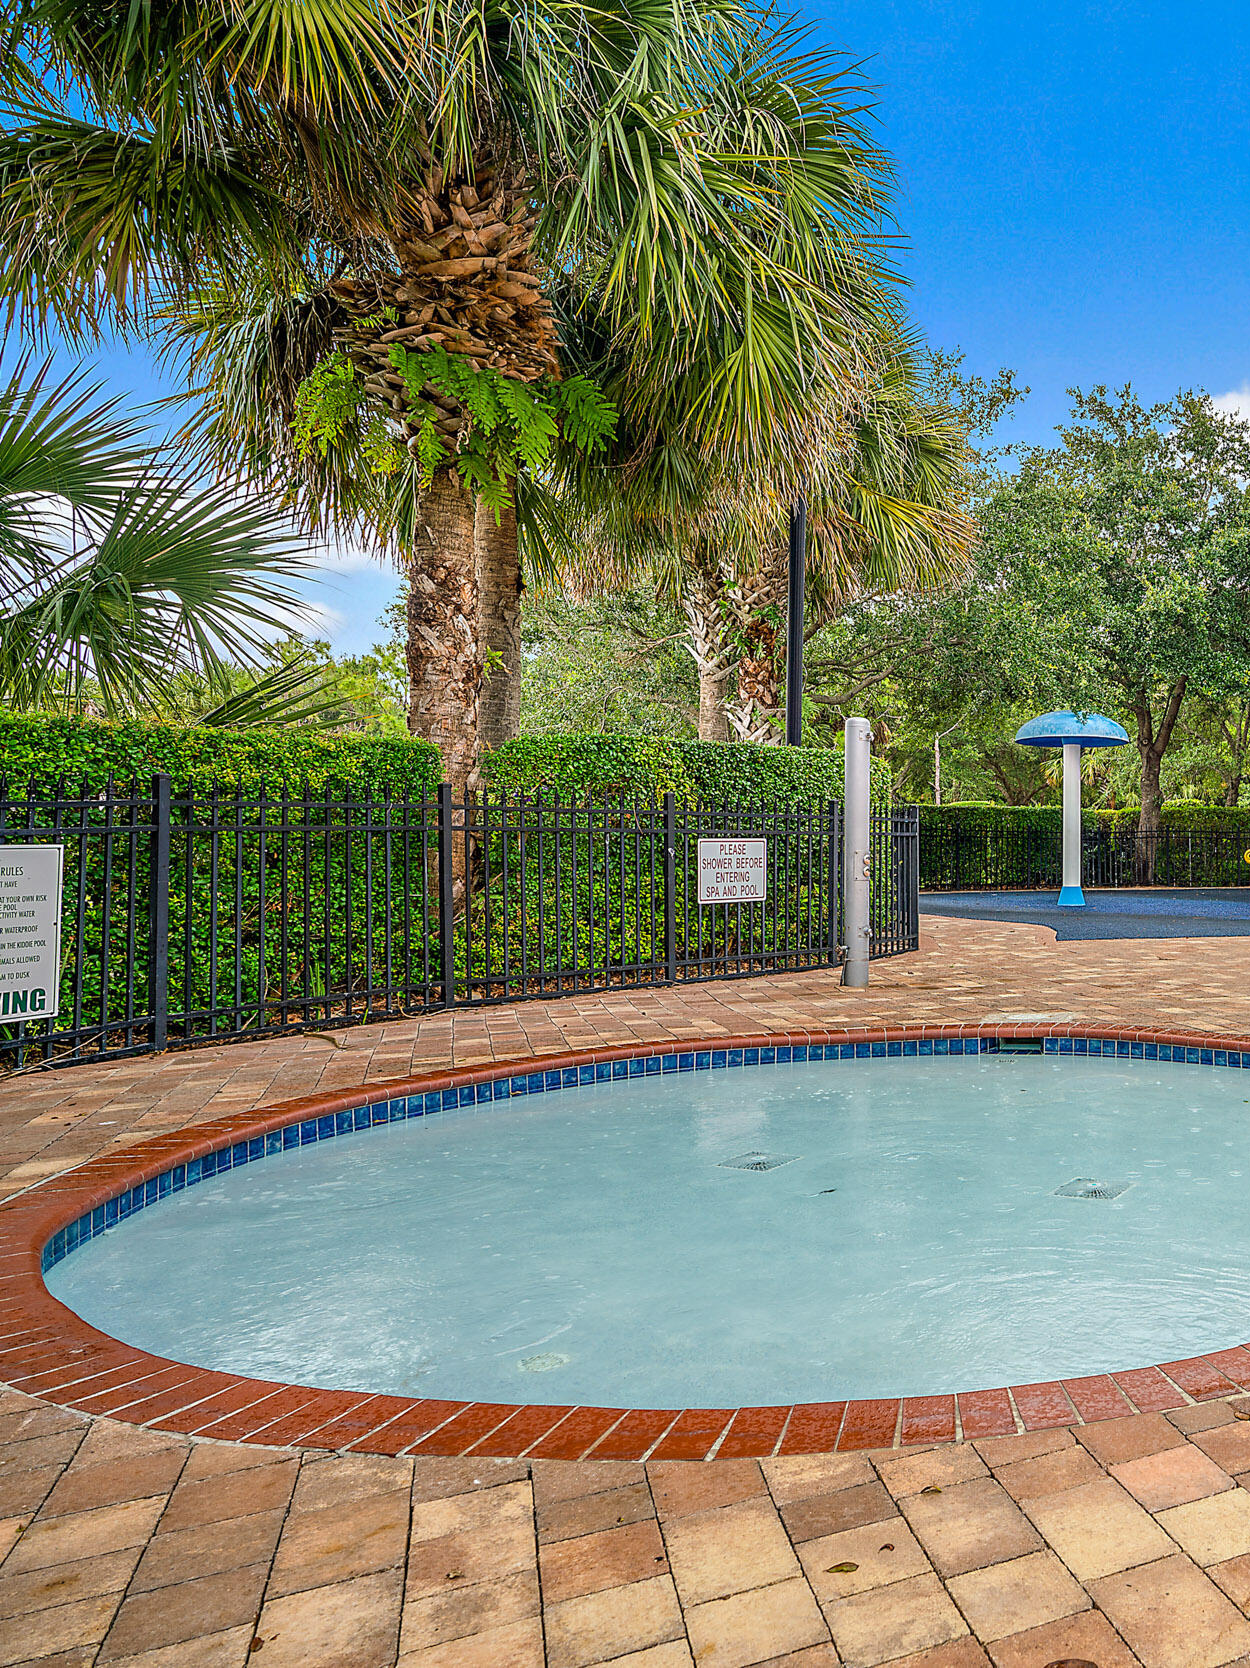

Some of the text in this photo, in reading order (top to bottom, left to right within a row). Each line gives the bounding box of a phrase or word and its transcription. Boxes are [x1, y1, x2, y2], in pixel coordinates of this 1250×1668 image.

[720, 844, 746, 855] PLEASE
[702, 857, 763, 869] SHOWER BEFORE
[0, 866, 24, 876] RULES
[716, 871, 750, 883] ENTERING
[706, 884, 759, 897] SPA AND POOL
[6, 895, 20, 903] YOUR
[3, 903, 17, 911] POOL
[19, 910, 35, 918] WATER
[5, 925, 38, 934] WATERPROOF
[17, 940, 33, 949] KIDDIE
[16, 955, 40, 963] ALLOWED
[15, 971, 30, 979] DUSK
[0, 988, 46, 1015] ING
